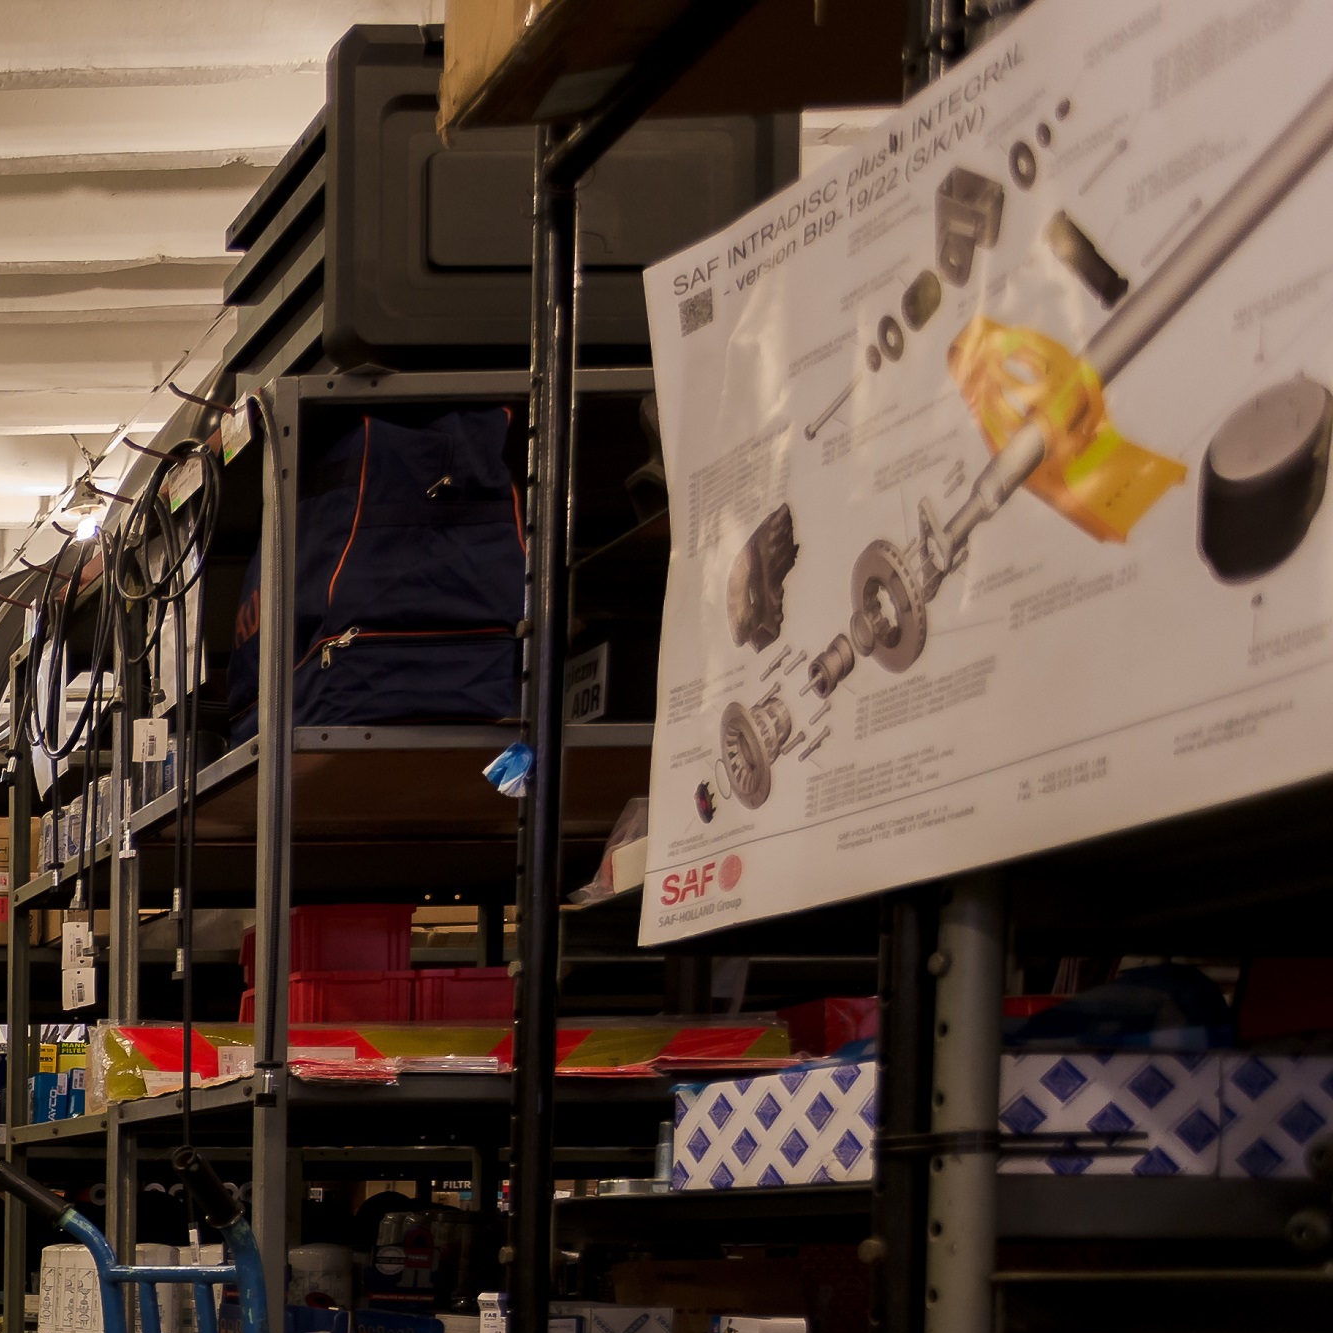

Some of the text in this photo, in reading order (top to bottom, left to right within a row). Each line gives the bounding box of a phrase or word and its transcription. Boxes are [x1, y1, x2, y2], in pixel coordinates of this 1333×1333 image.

[672, 256, 721, 297] SAF
[727, 180, 840, 270] INTRADISC
[845, 143, 887, 194] plus
[911, 44, 1025, 147] INTEGRAL
[734, 240, 797, 294] version
[572, 683, 601, 720] ADR
[660, 862, 715, 906] SAF
[658, 898, 741, 928] SAF-HOLLAND Group
